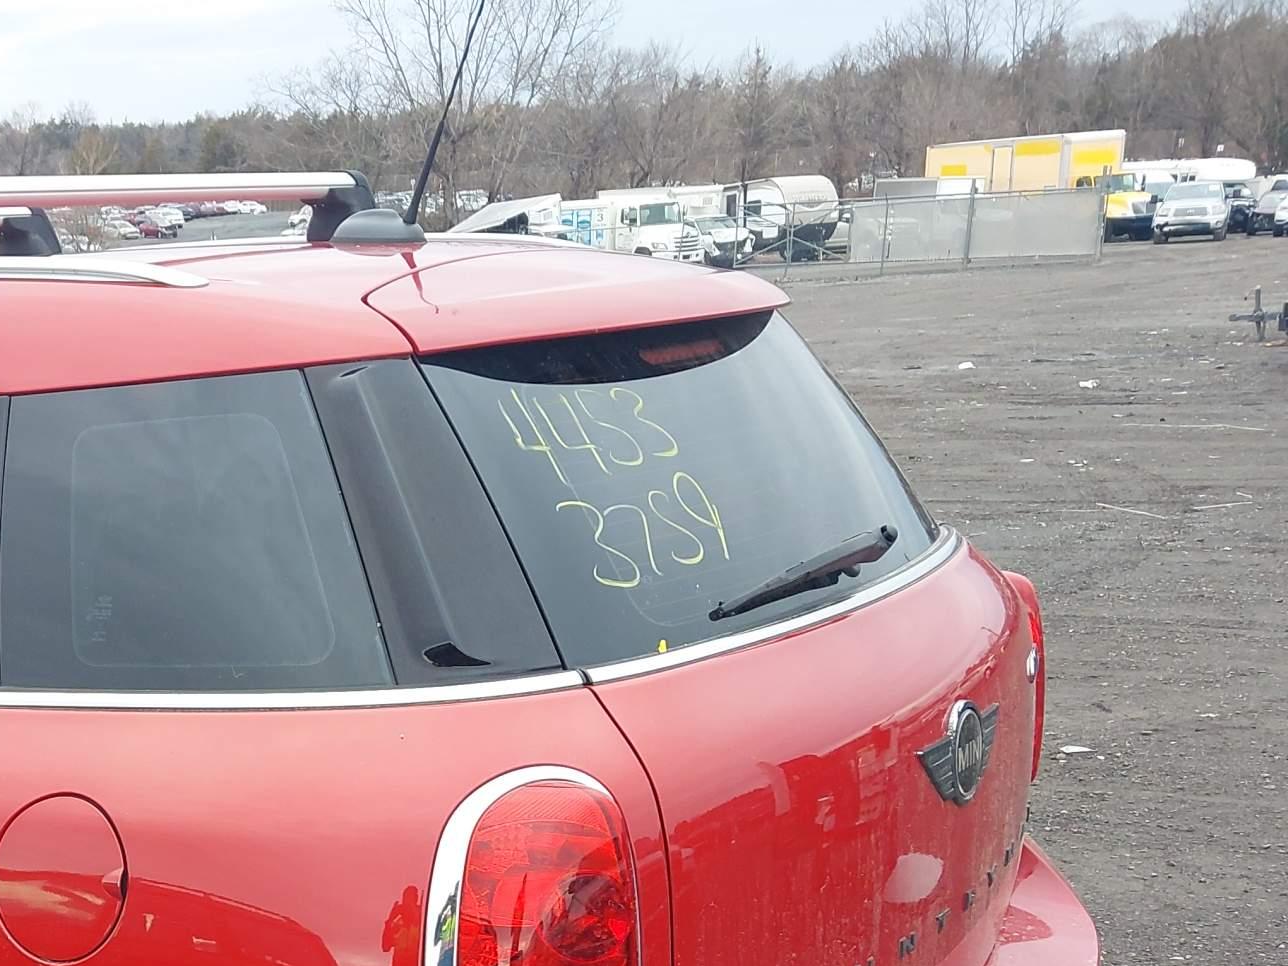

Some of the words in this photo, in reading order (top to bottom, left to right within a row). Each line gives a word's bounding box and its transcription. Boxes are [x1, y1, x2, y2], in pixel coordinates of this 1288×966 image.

[498, 387, 679, 486] 4453
[555, 471, 730, 588] 3759
[957, 735, 982, 773] MINI
